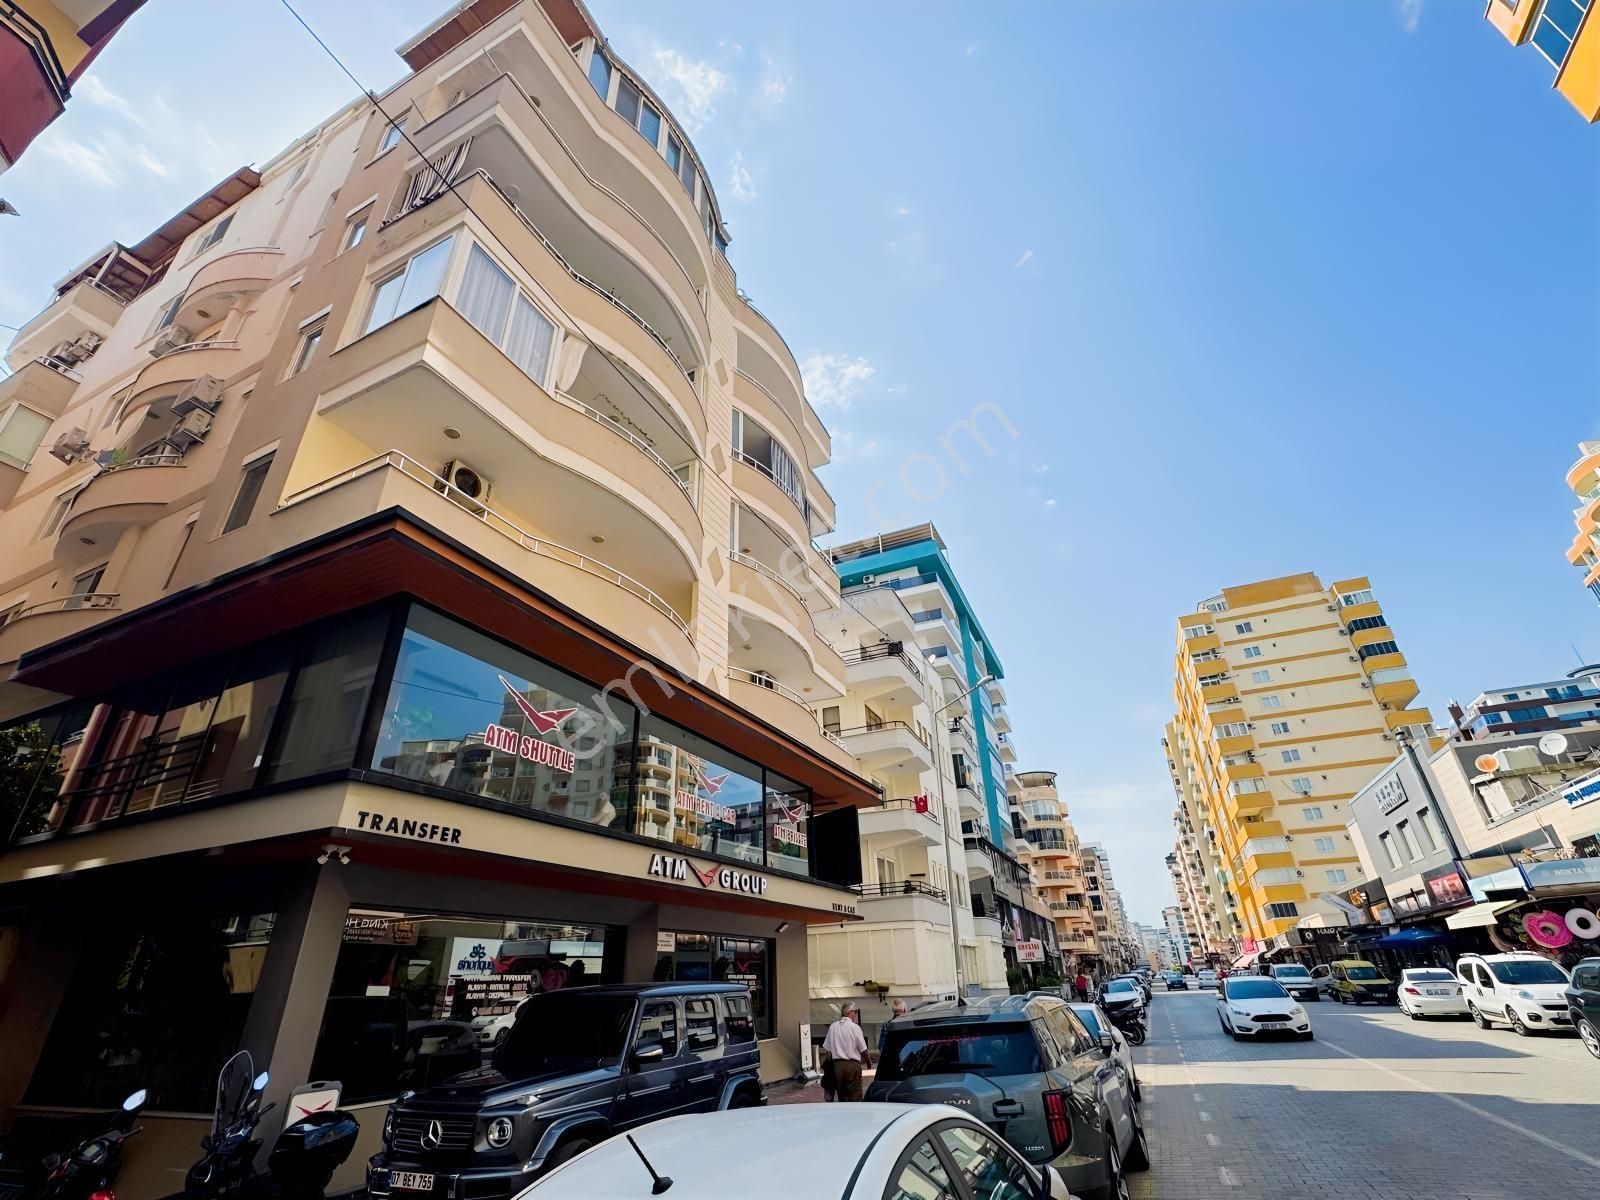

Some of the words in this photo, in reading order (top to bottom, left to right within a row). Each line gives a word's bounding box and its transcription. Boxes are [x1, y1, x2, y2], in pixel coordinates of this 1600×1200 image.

[484, 724, 519, 754] ATM
[520, 736, 575, 773] SHUTTLE
[675, 791, 695, 812] ATM
[695, 797, 715, 820] RENT
[358, 810, 462, 844] TRANSFER
[649, 854, 687, 880] ATM
[719, 869, 768, 895] GROUP
[402, 1173, 417, 1187] BEY
